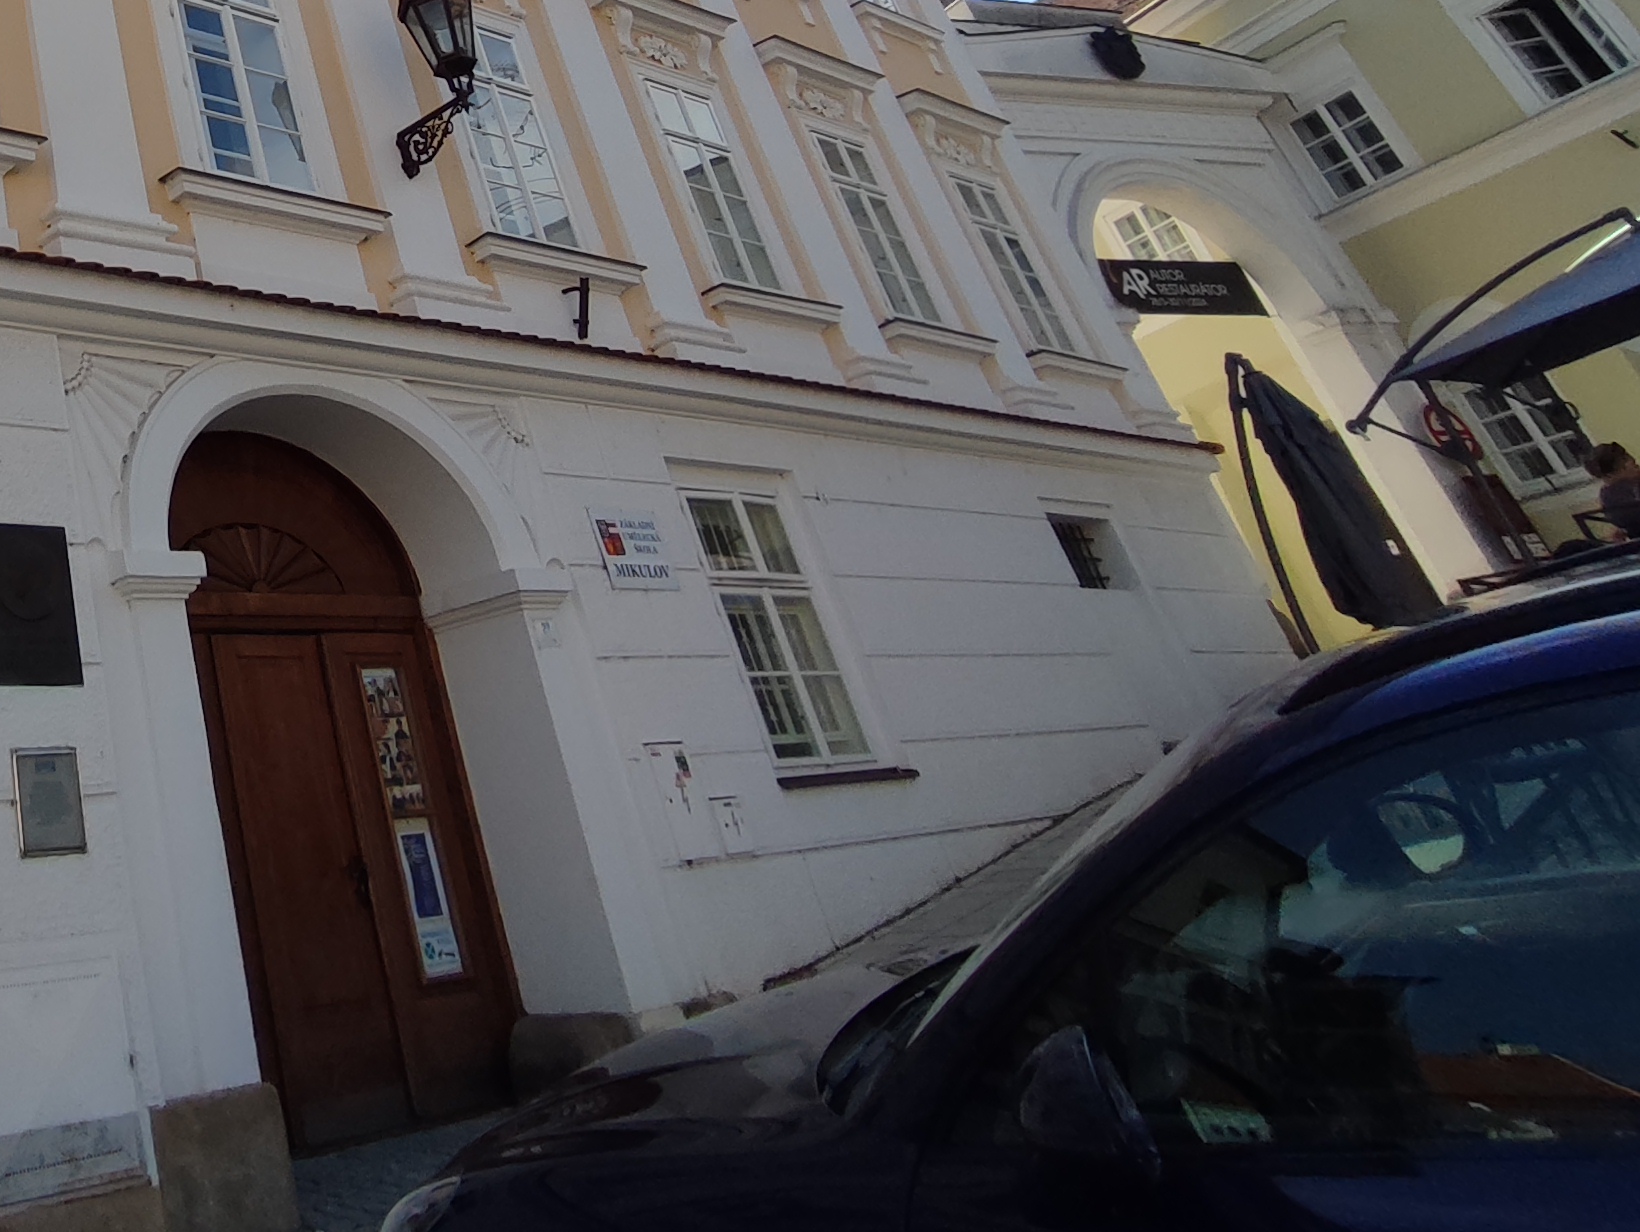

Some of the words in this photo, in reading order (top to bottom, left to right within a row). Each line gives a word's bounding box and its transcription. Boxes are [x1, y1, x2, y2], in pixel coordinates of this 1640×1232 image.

[1149, 269, 1185, 281] AUTOR
[1122, 268, 1158, 299] AR
[1156, 282, 1228, 296] RESTAURÁTOR
[613, 564, 669, 578] MIKULOV
